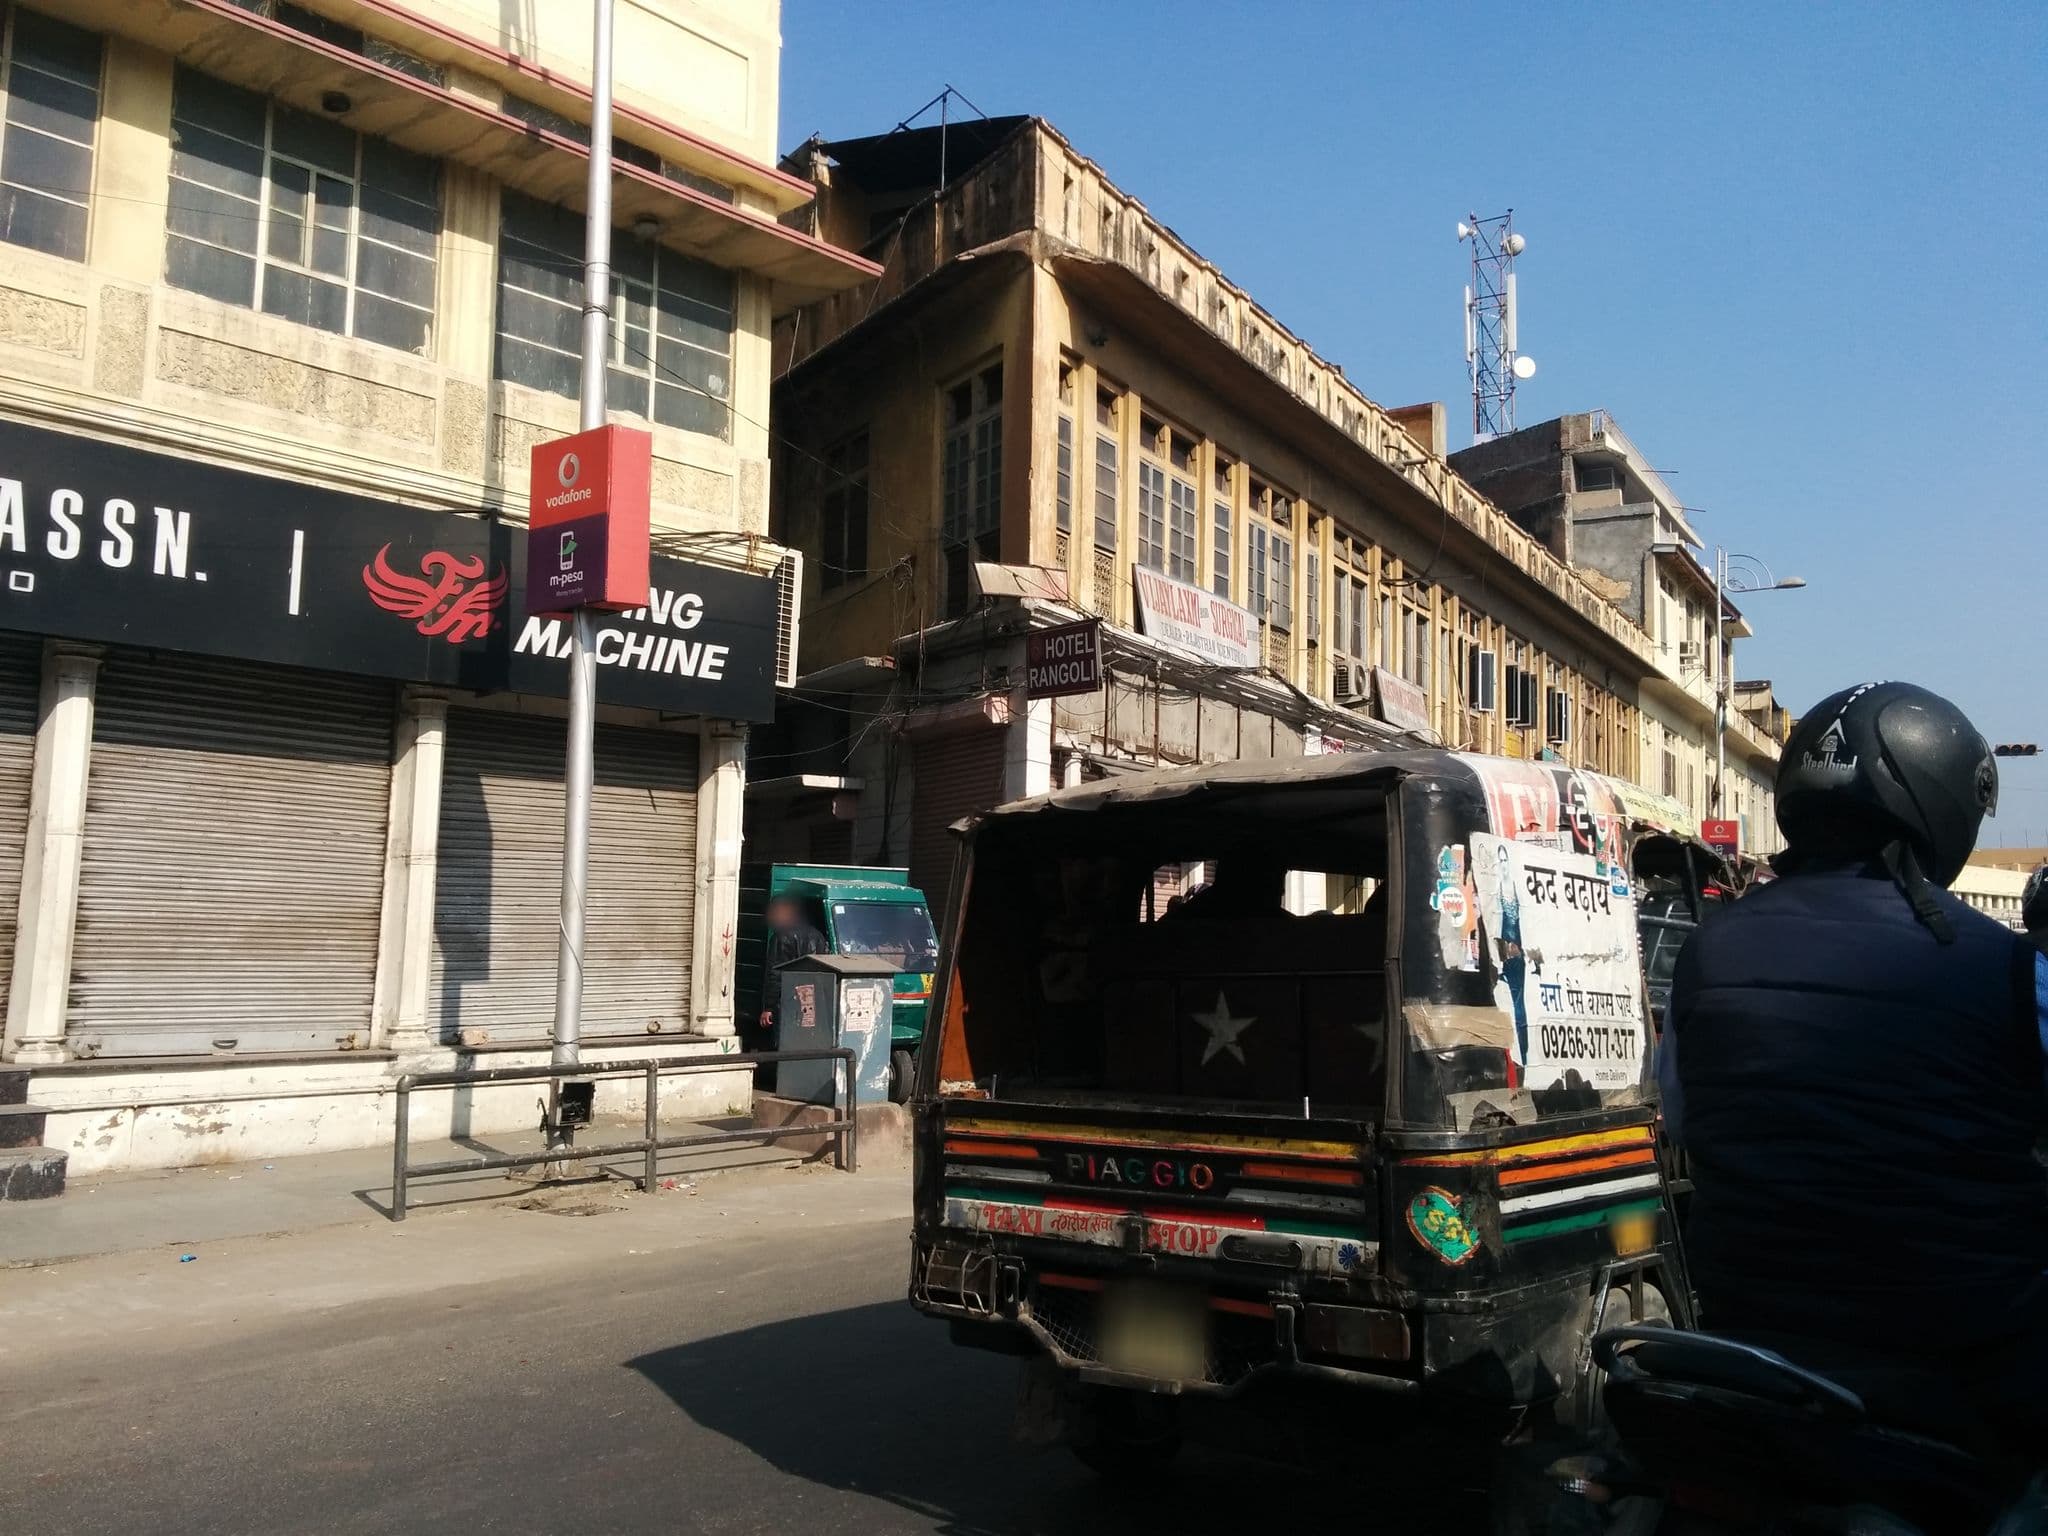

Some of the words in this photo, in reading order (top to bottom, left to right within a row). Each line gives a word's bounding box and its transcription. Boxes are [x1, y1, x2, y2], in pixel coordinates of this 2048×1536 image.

[545, 487, 592, 508] vodafone
[0, 477, 207, 582] ASSN.
[550, 570, 584, 587] m-pesa
[1045, 631, 1094, 659] HOTEL
[1030, 659, 1095, 689] RANGOLI
[1524, 864, 1558, 910] कद
[1586, 991, 1614, 1017] वापस
[1541, 1024, 1635, 1060] 09266-377-377
[1065, 1152, 1214, 1190] PIAGGIO
[983, 1204, 1044, 1237] TAXI
[1147, 1222, 1218, 1254] STOP
